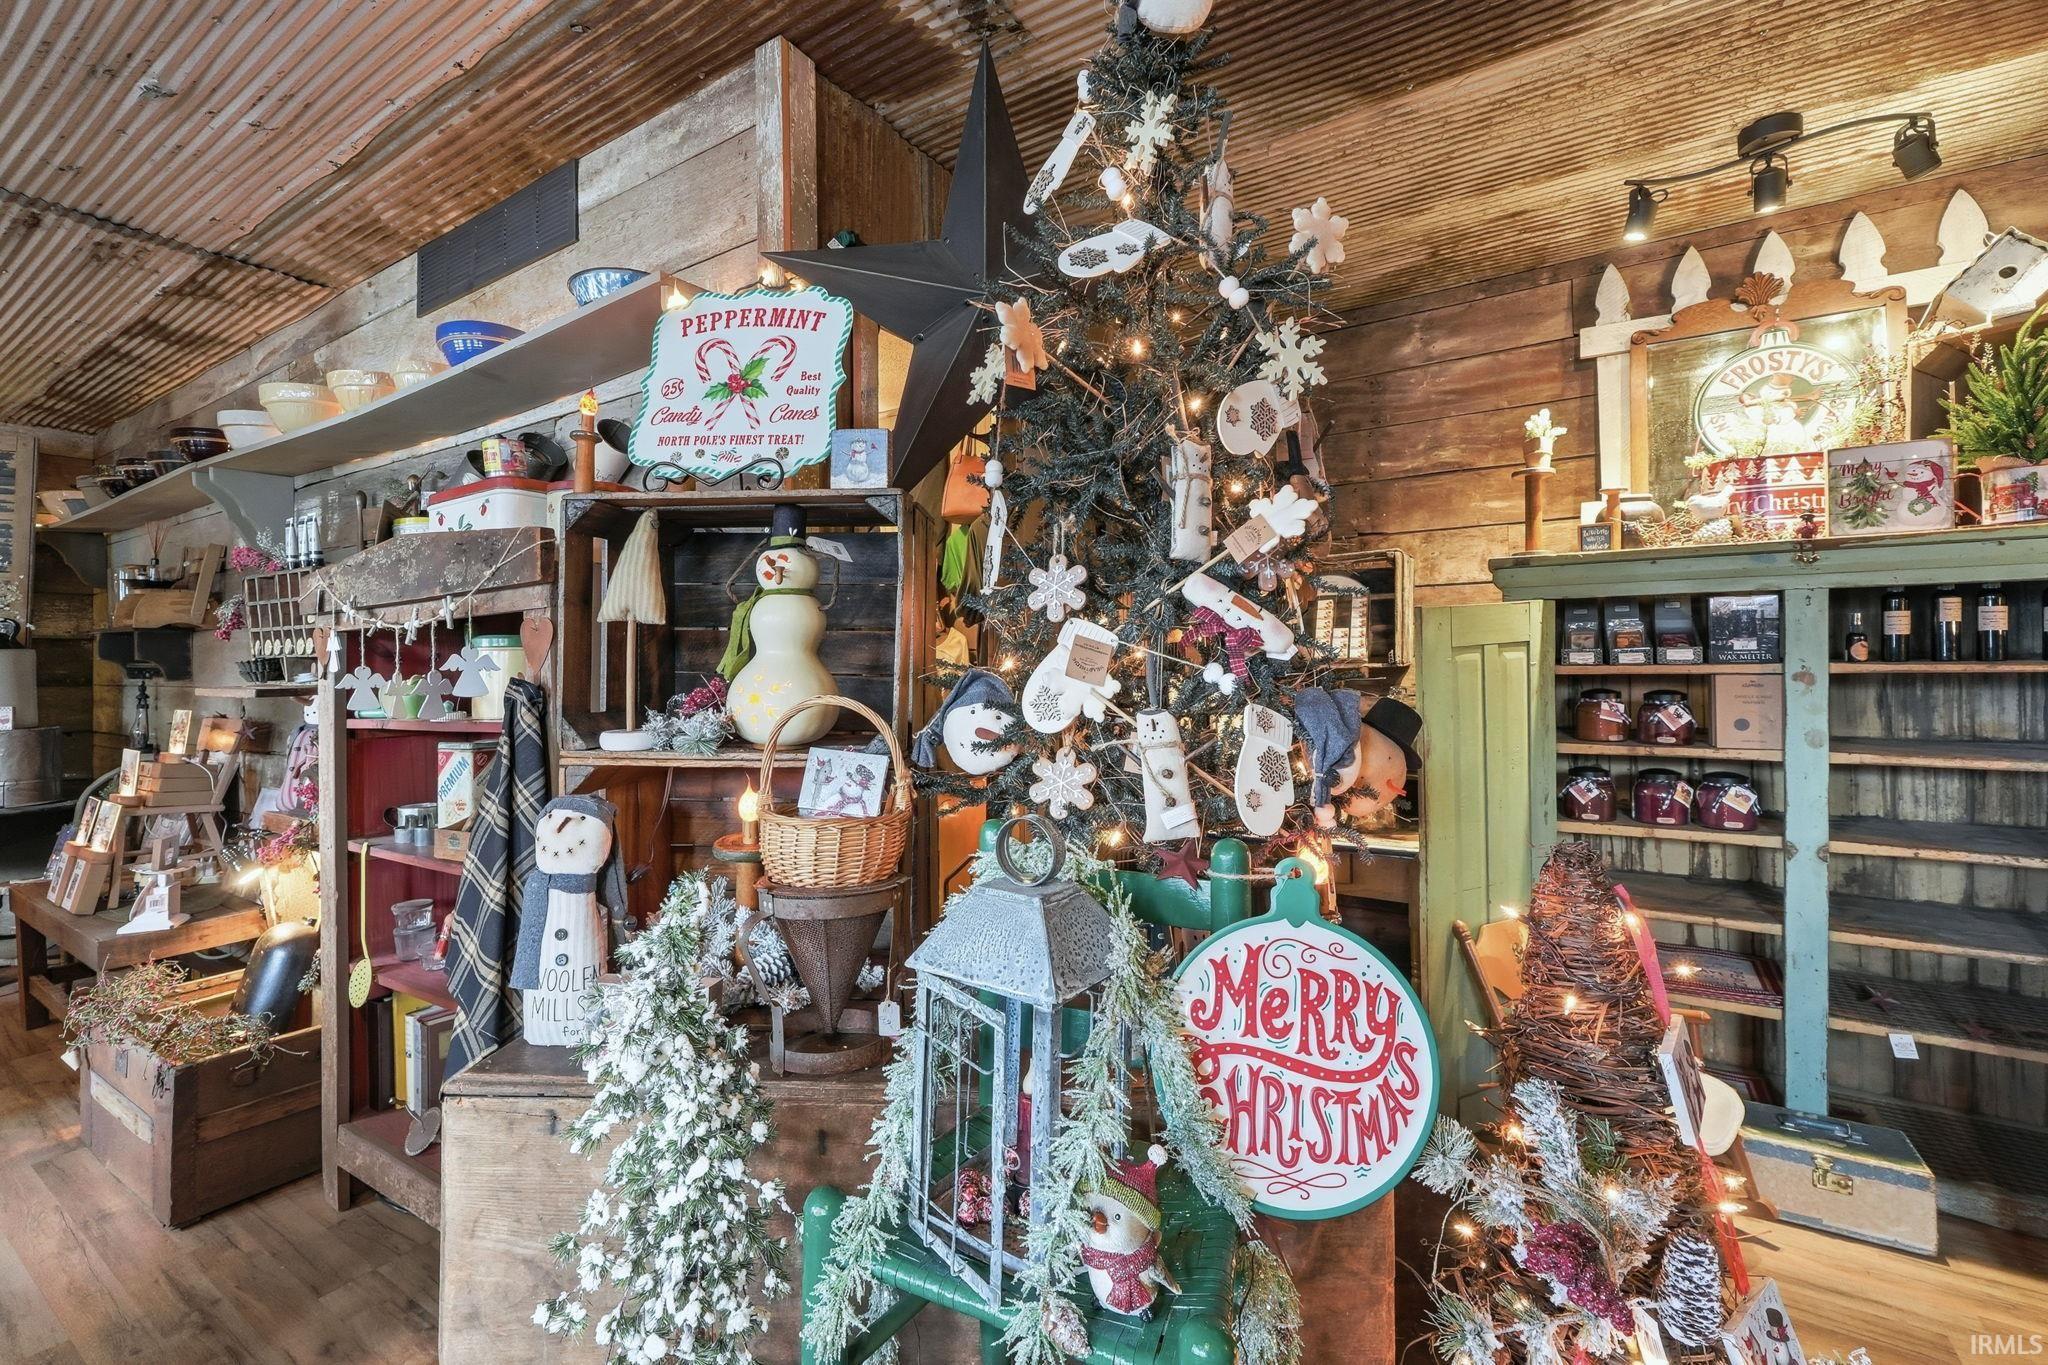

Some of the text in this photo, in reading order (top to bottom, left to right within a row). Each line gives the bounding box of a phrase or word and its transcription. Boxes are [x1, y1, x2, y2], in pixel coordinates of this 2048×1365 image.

[680, 307, 826, 337] PEPPERMINT
[800, 371, 821, 381] Best
[786, 385, 821, 396] Quality
[650, 403, 820, 426] Candy Canes
[657, 434, 805, 447] NORTH POLE'S FINEST TREAT!
[438, 756, 470, 803] PREMIUM
[531, 995, 586, 1022] MILLS
